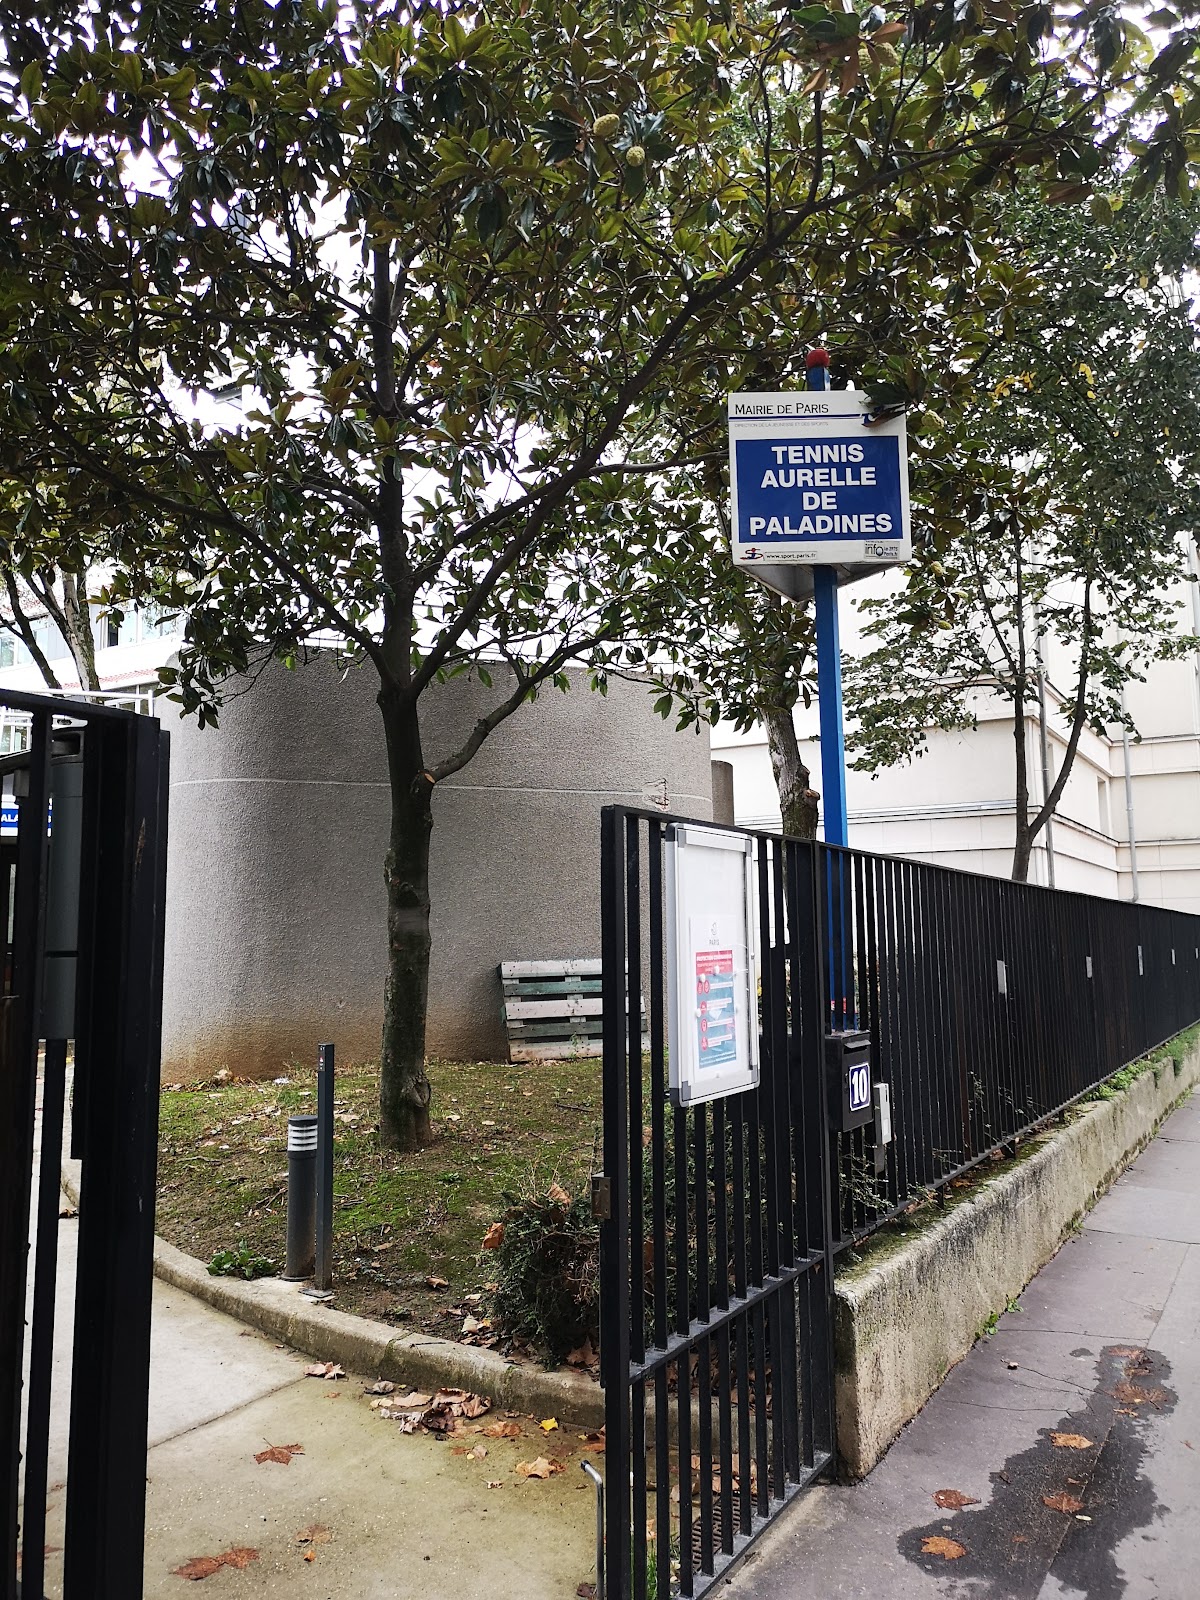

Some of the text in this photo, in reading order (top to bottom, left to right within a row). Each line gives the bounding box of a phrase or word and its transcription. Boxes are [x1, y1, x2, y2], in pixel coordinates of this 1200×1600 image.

[735, 402, 829, 415] MAIRIE DE PARIS
[771, 444, 864, 464] TENNIS
[760, 467, 877, 488] AURELLE
[802, 491, 838, 511] DE
[750, 514, 893, 536] PALADINES
[852, 1068, 868, 1105] 10
